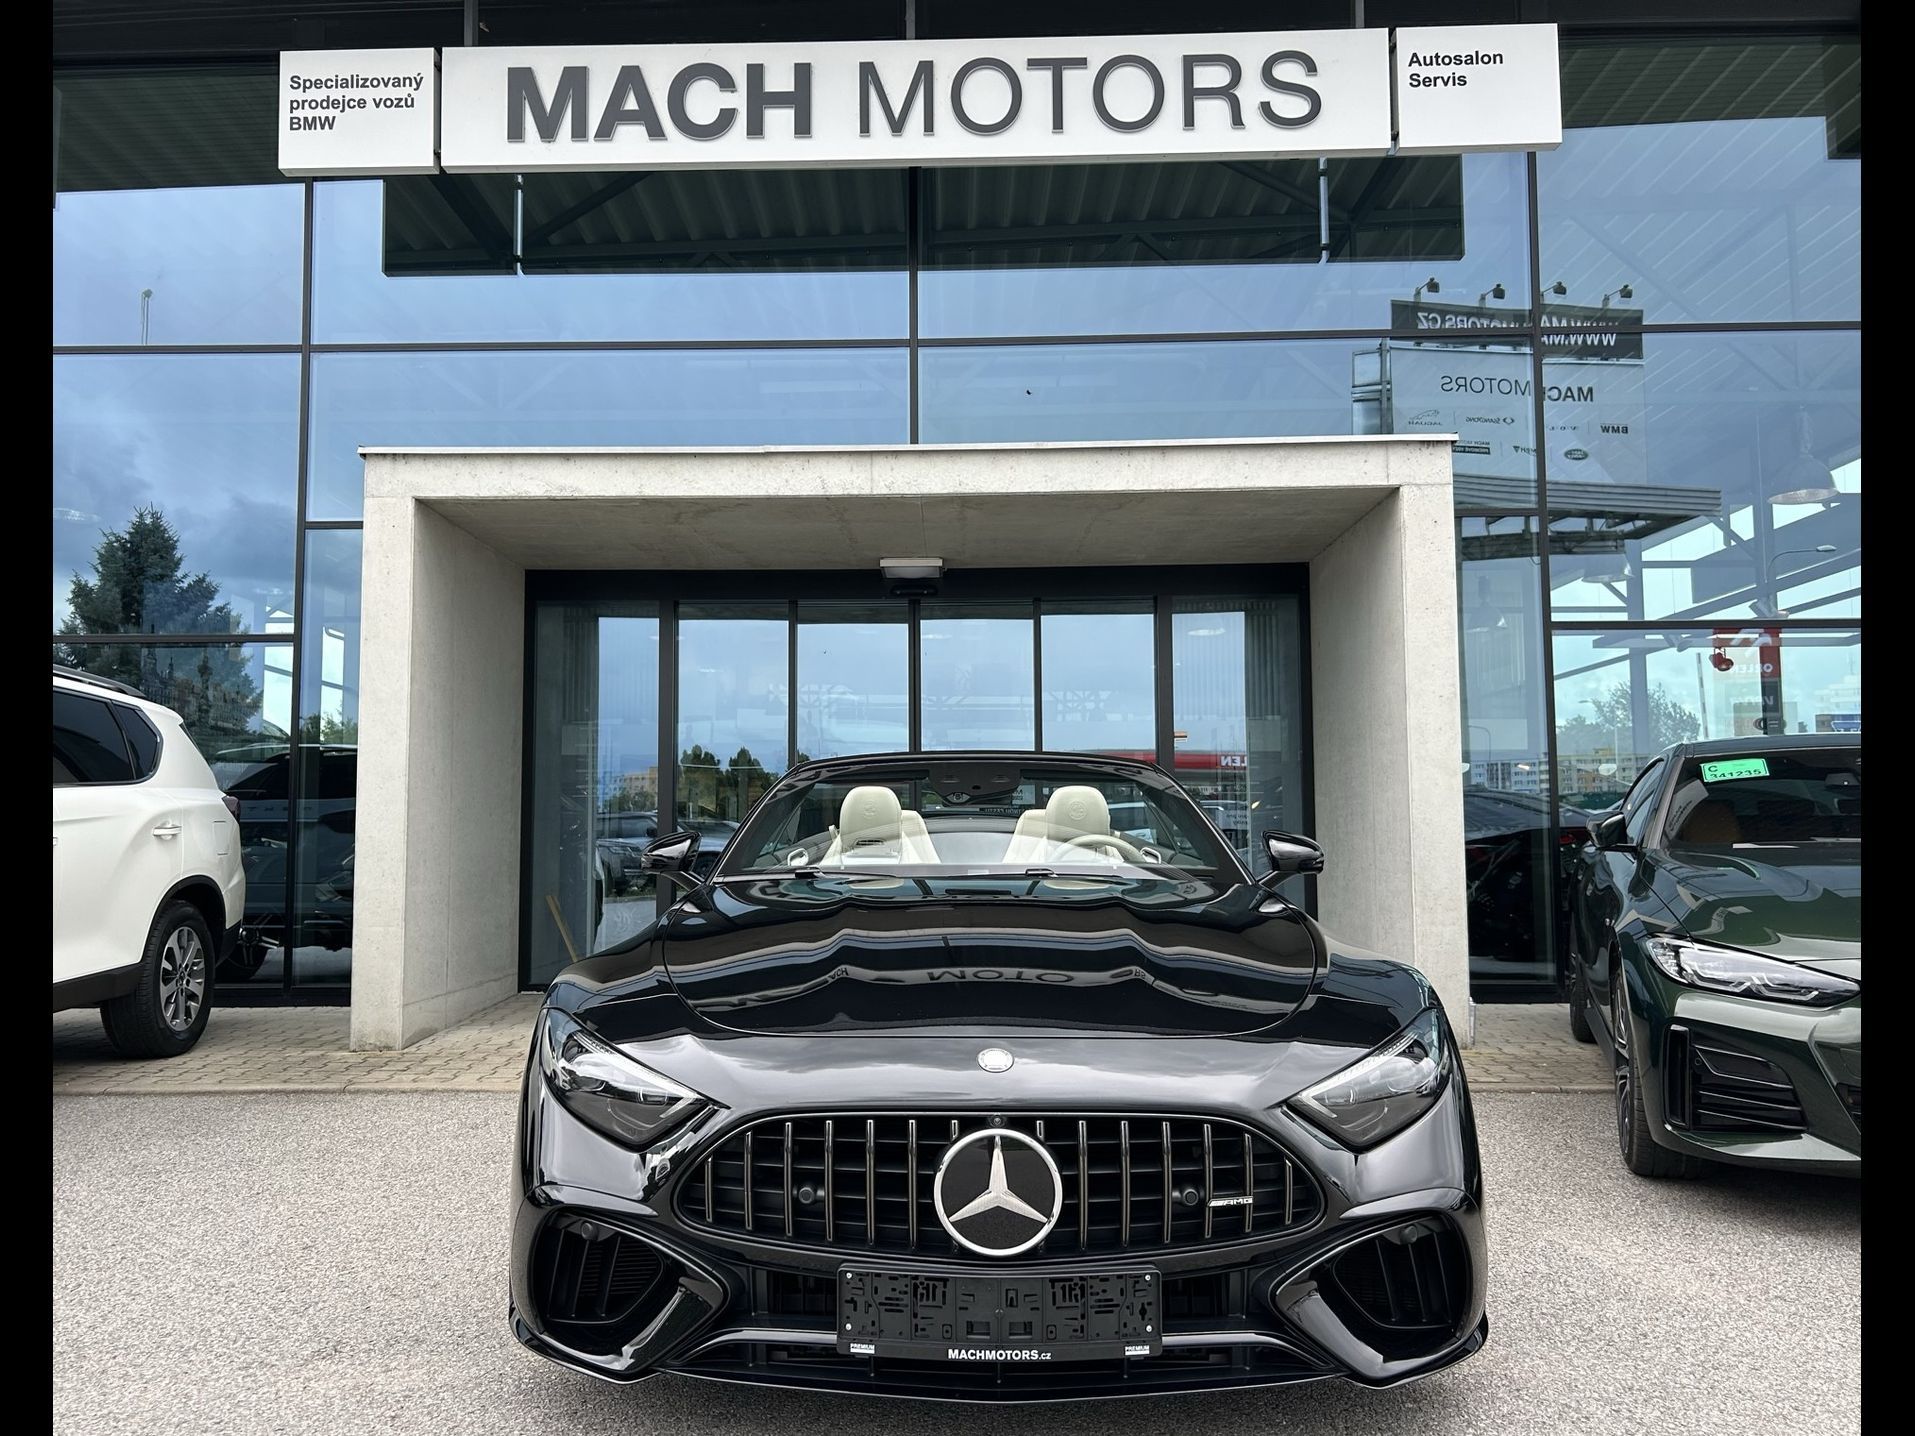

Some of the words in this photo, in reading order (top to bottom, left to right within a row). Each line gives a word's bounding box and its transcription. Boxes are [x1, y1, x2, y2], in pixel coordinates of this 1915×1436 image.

[1408, 50, 1504, 67] Autosalon
[289, 72, 424, 93] Specializovaný
[1409, 72, 1468, 88] Servis
[289, 95, 367, 114] prodejce
[373, 93, 415, 109] vozů
[507, 62, 812, 144] MACH
[858, 49, 1323, 136] MOTORS
[289, 116, 336, 131] BMW
[948, 1349, 1052, 1360] MACHMOTORS.cz
